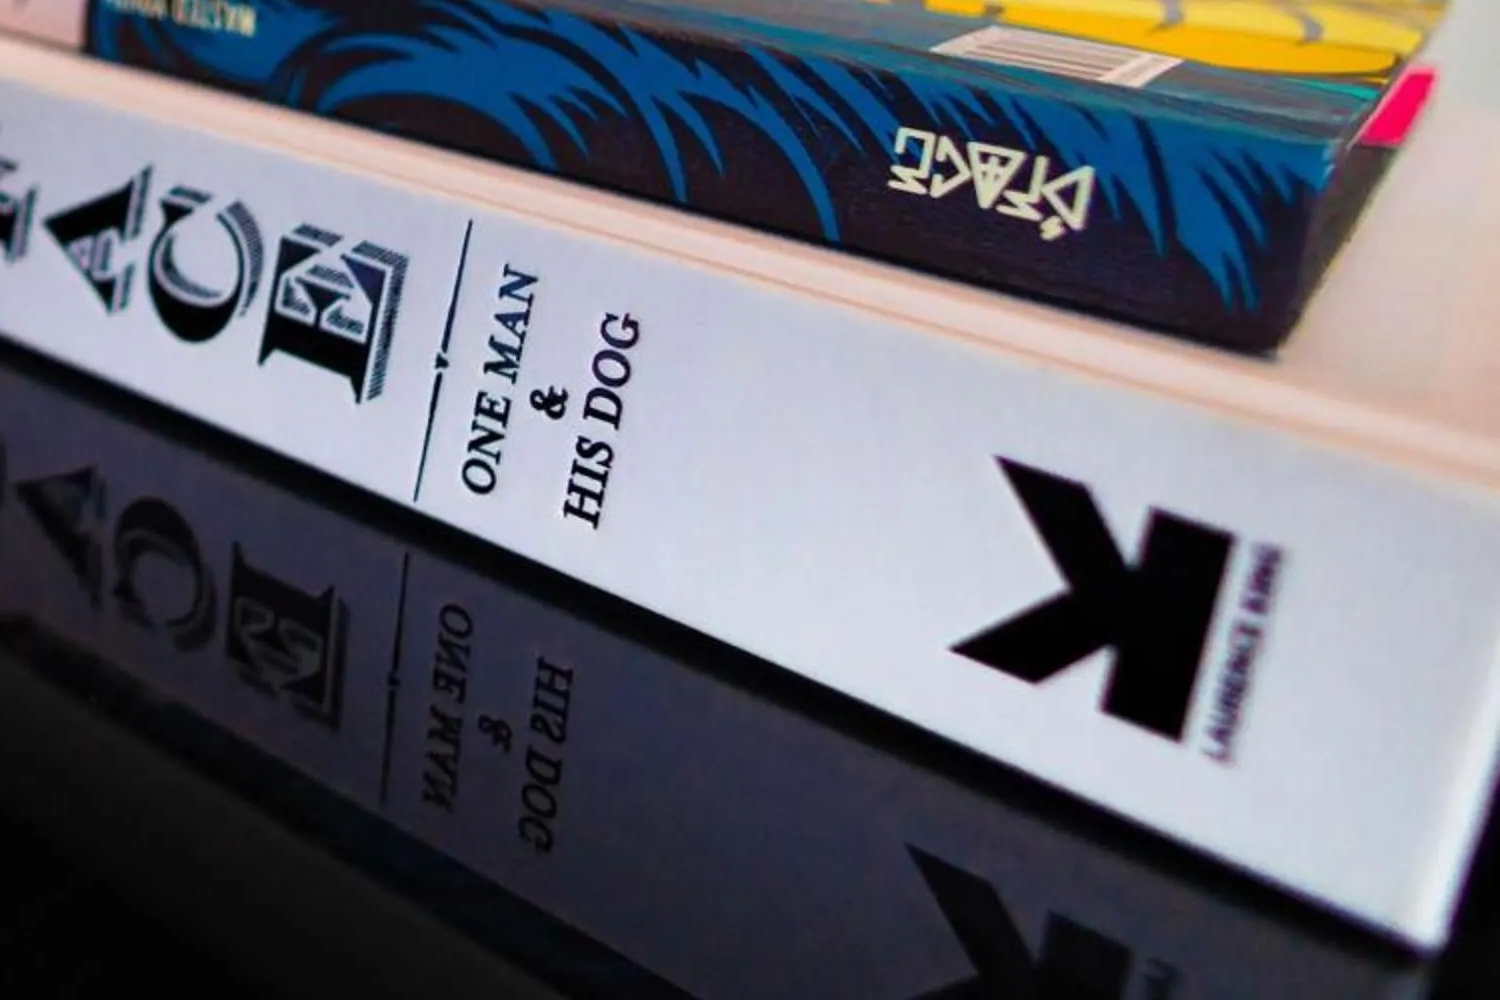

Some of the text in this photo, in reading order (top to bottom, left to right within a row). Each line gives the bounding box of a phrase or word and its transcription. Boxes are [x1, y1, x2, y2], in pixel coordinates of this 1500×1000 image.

[461, 264, 539, 496] ONE MAN
[529, 386, 568, 420] &
[563, 312, 640, 530] HIS DOG
[946, 455, 1236, 743] K
[1238, 541, 1285, 615] KING
